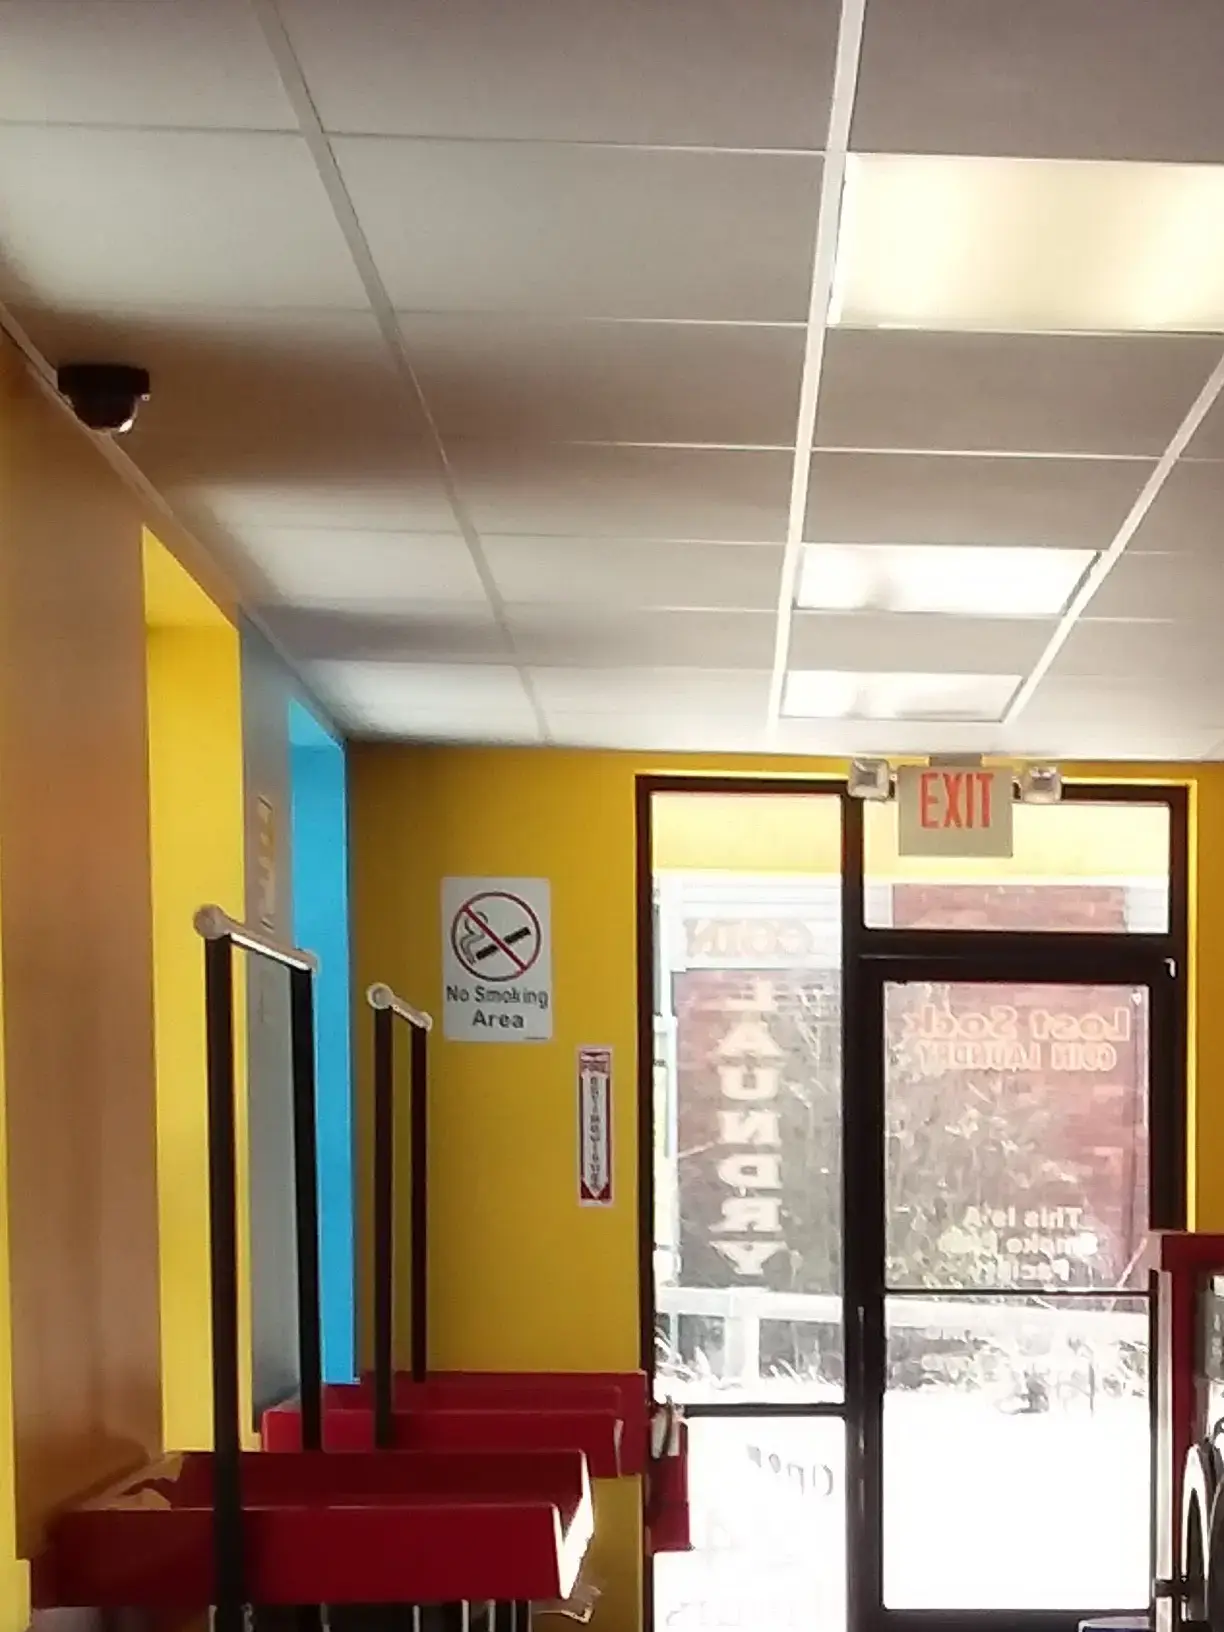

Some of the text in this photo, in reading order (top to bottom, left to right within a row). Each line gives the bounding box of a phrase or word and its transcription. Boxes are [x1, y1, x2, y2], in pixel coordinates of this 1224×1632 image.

[918, 772, 995, 829] EXIT
[446, 985, 548, 1008] No Smoking
[472, 1012, 525, 1029] Area
